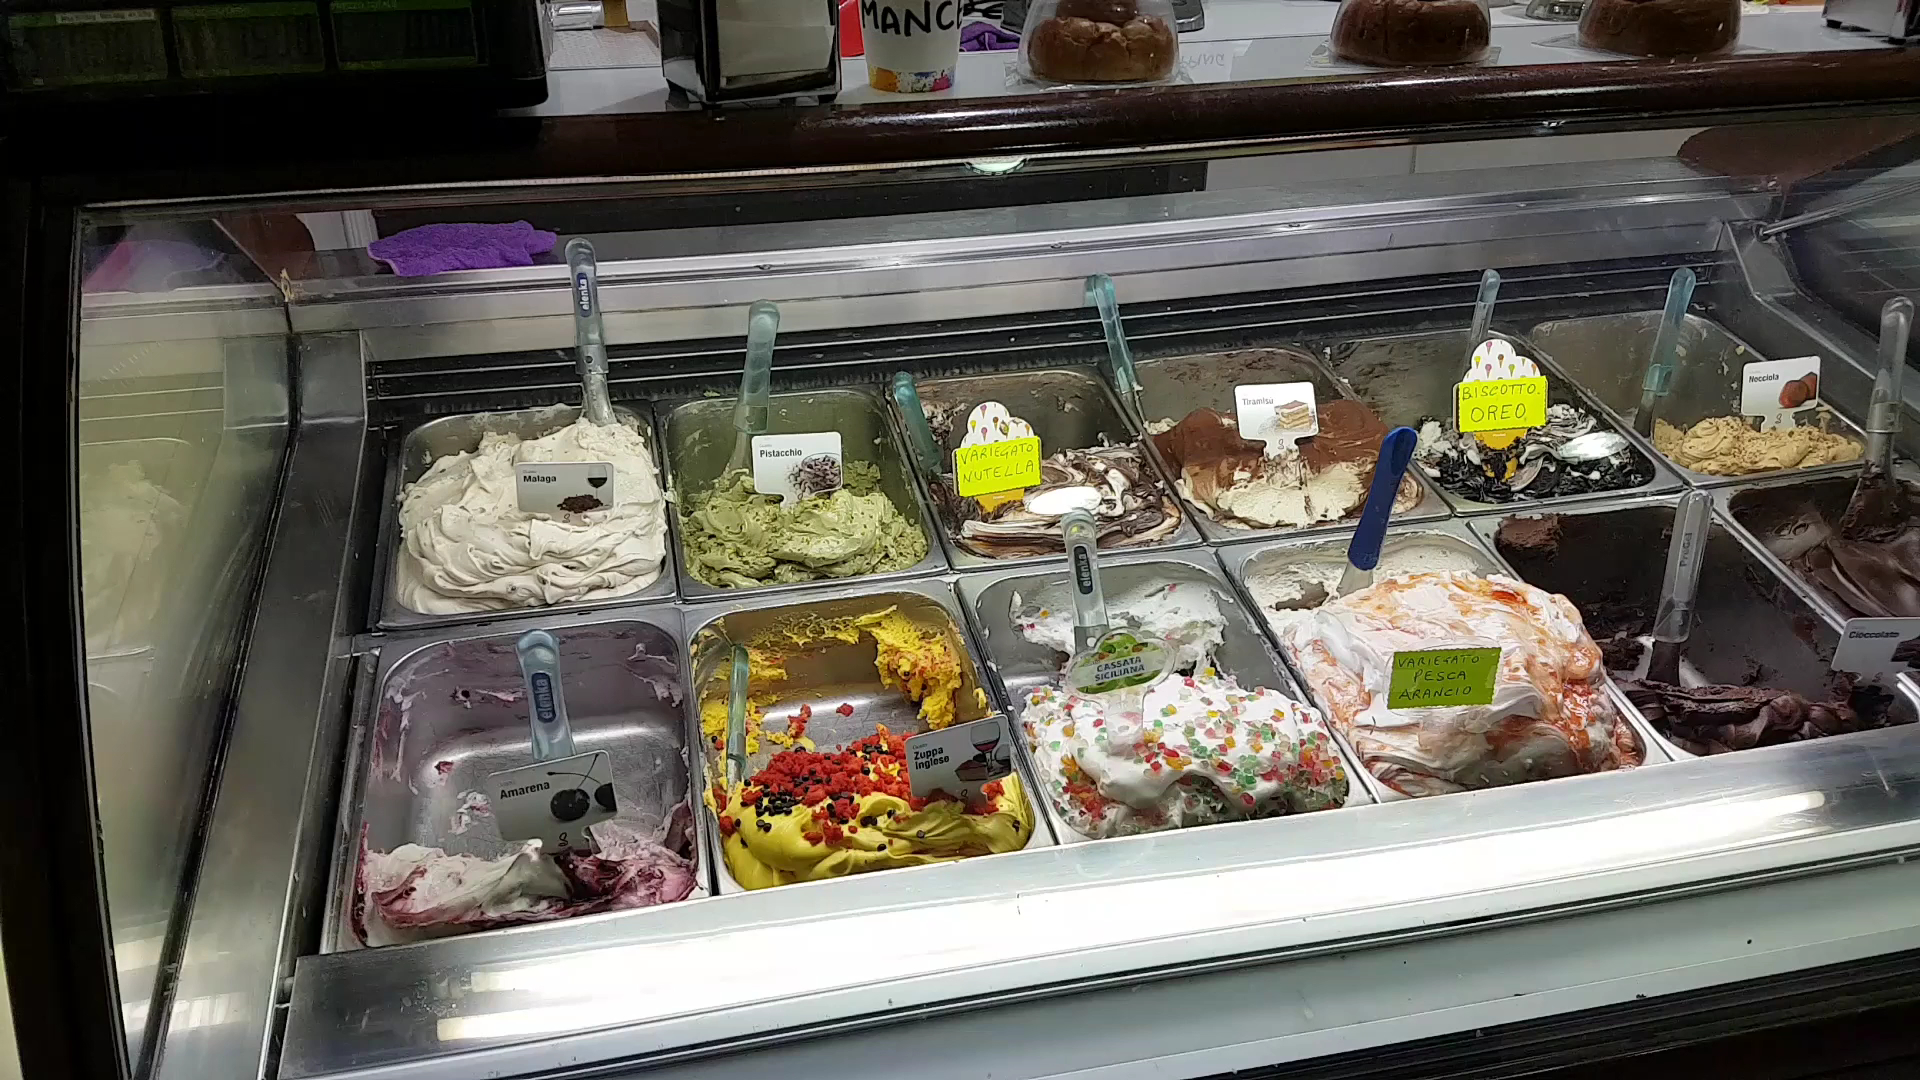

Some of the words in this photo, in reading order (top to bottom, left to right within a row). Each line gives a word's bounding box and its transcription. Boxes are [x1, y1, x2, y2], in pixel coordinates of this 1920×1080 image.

[578, 278, 591, 311] elenka
[1748, 373, 1780, 383] Nocciola
[759, 448, 803, 458] Pistacchio
[960, 442, 1034, 465] VARIEGATO
[963, 459, 1034, 483] NUTELLA
[523, 475, 557, 483] Malaga
[1077, 553, 1092, 587] elenka
[1848, 631, 1900, 639] Cioccolato
[1096, 656, 1142, 672] CASSATA
[1094, 664, 1145, 682] SICILIANA
[1413, 669, 1467, 682] PESCA
[535, 679, 553, 719] elenka
[1398, 686, 1472, 700] ARANCIO
[913, 747, 944, 760] Zuppa
[915, 755, 950, 770] Inglese
[500, 781, 550, 799] Amarena
